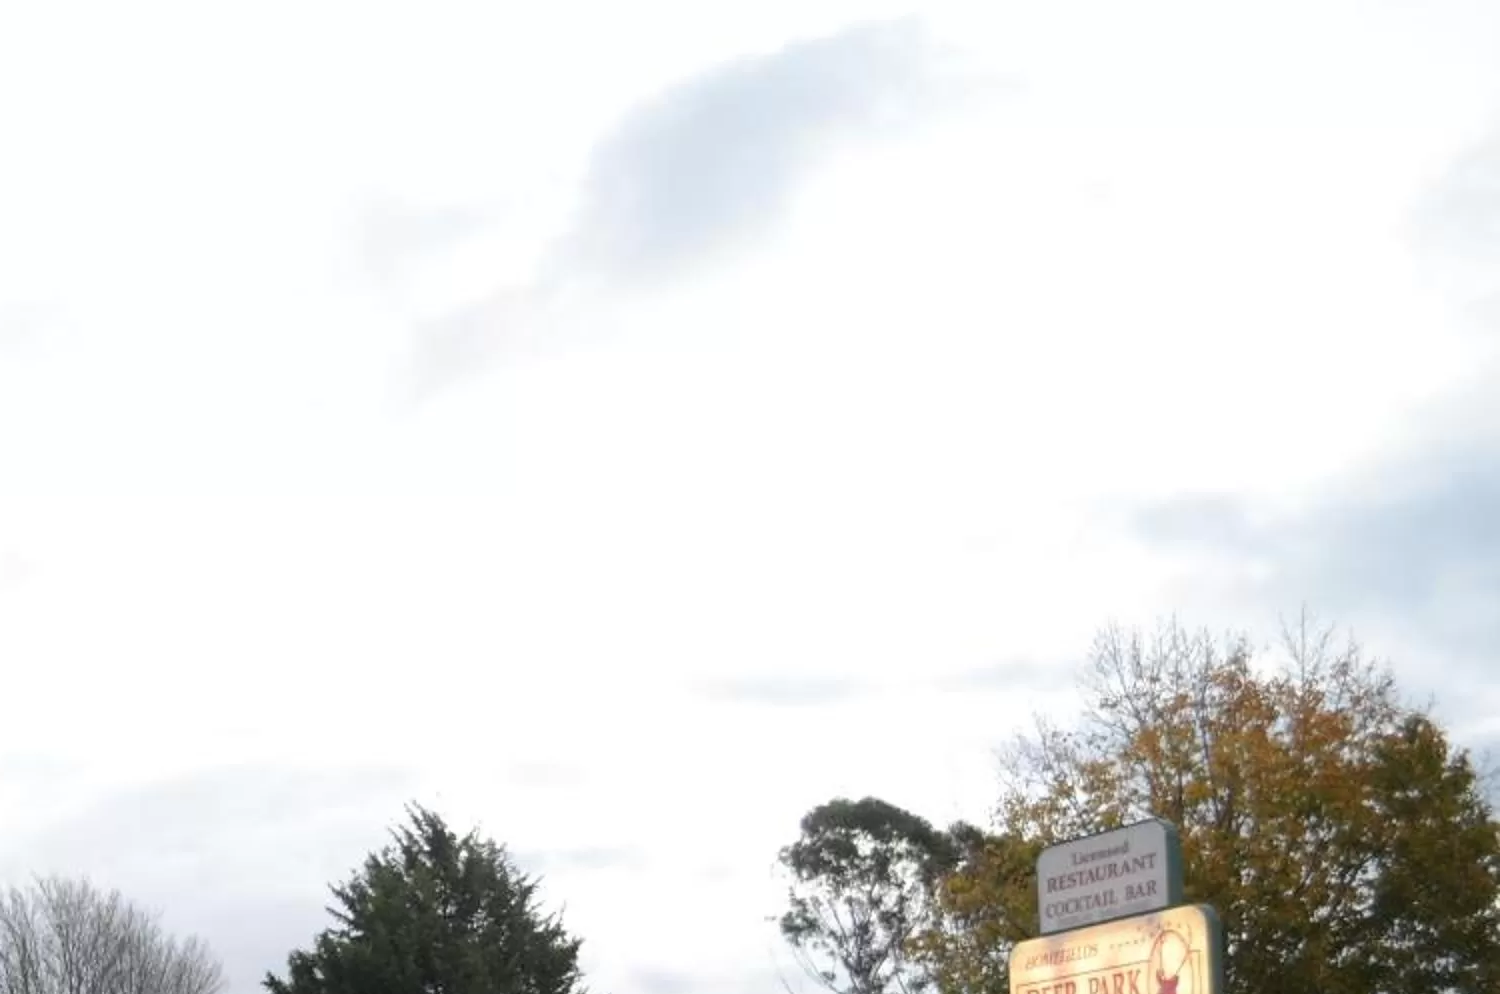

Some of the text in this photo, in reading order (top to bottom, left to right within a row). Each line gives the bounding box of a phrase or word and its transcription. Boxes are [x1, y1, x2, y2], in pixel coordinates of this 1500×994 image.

[1047, 852, 1157, 893] RESTAURANT
[1046, 880, 1157, 918] COCKTAIL BAR
